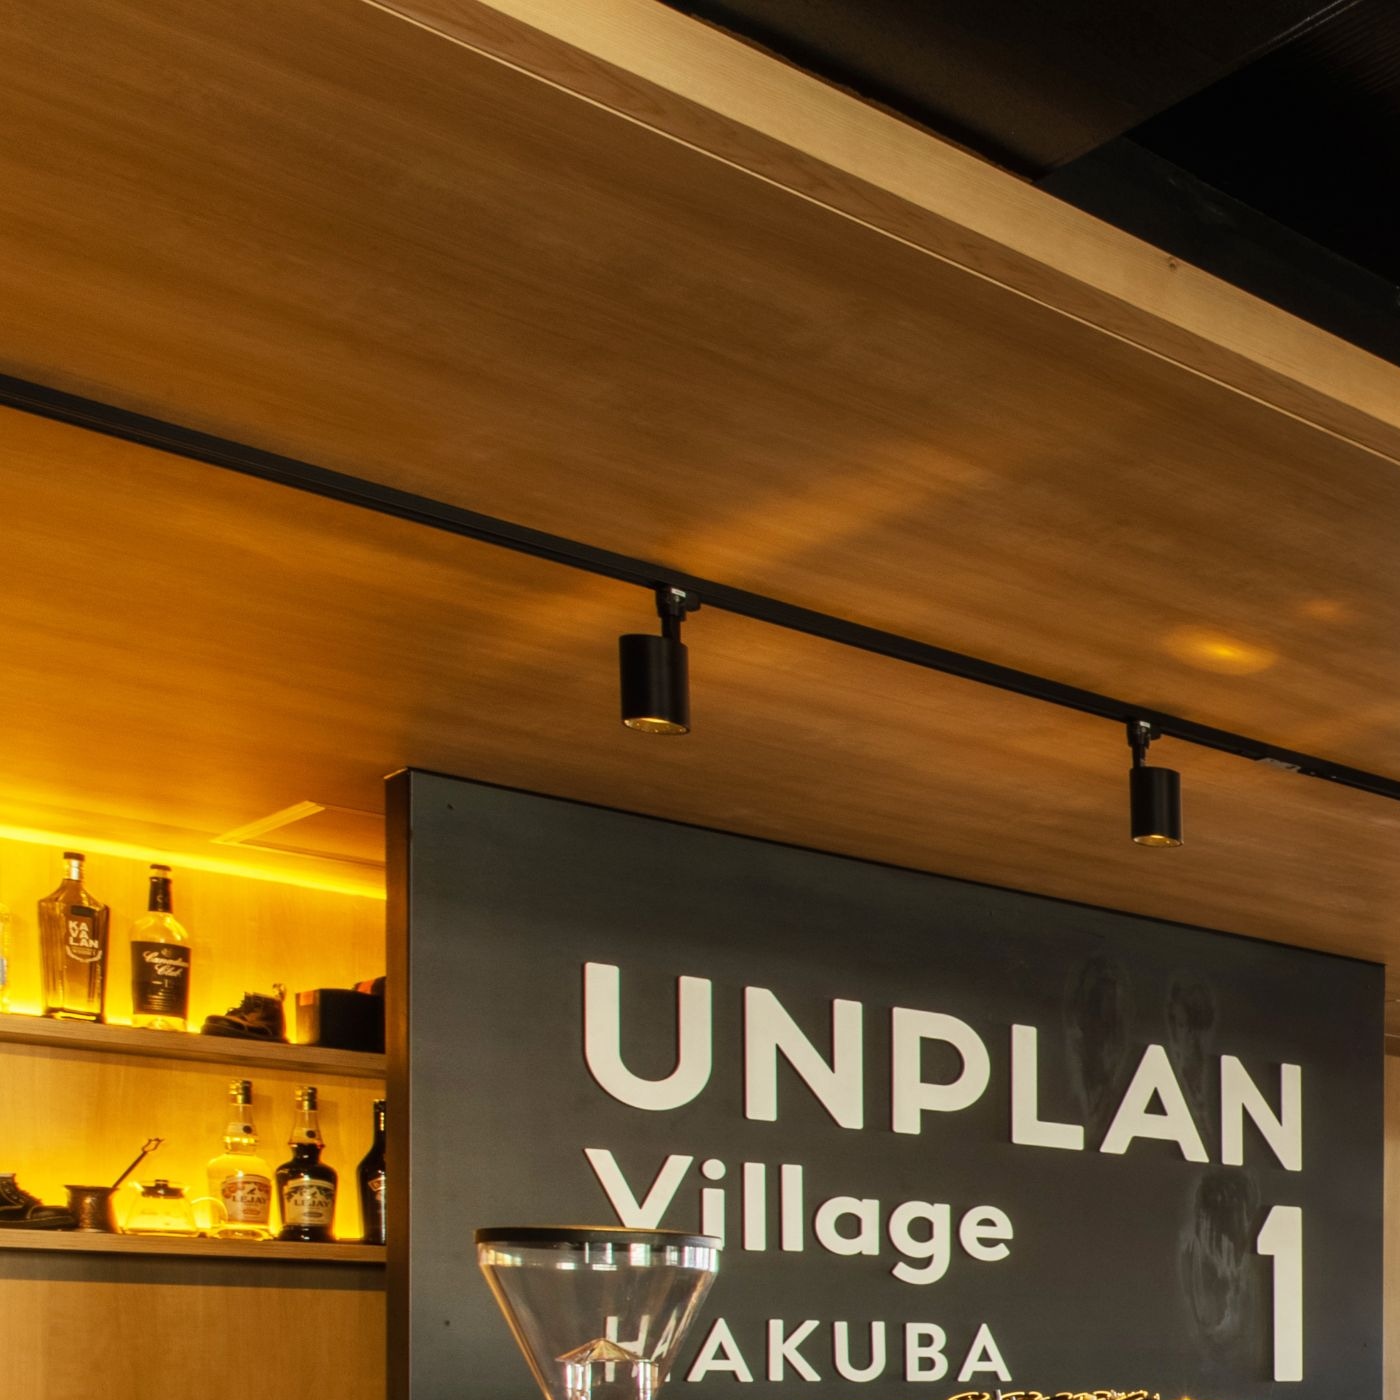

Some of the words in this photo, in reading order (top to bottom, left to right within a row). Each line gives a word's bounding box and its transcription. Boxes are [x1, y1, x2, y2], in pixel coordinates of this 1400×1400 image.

[583, 961, 1303, 1172] UNPLAN
[584, 1147, 1014, 1286] Village
[1257, 1205, 1303, 1382] 1
[605, 1314, 1013, 1383] HAKUBA
